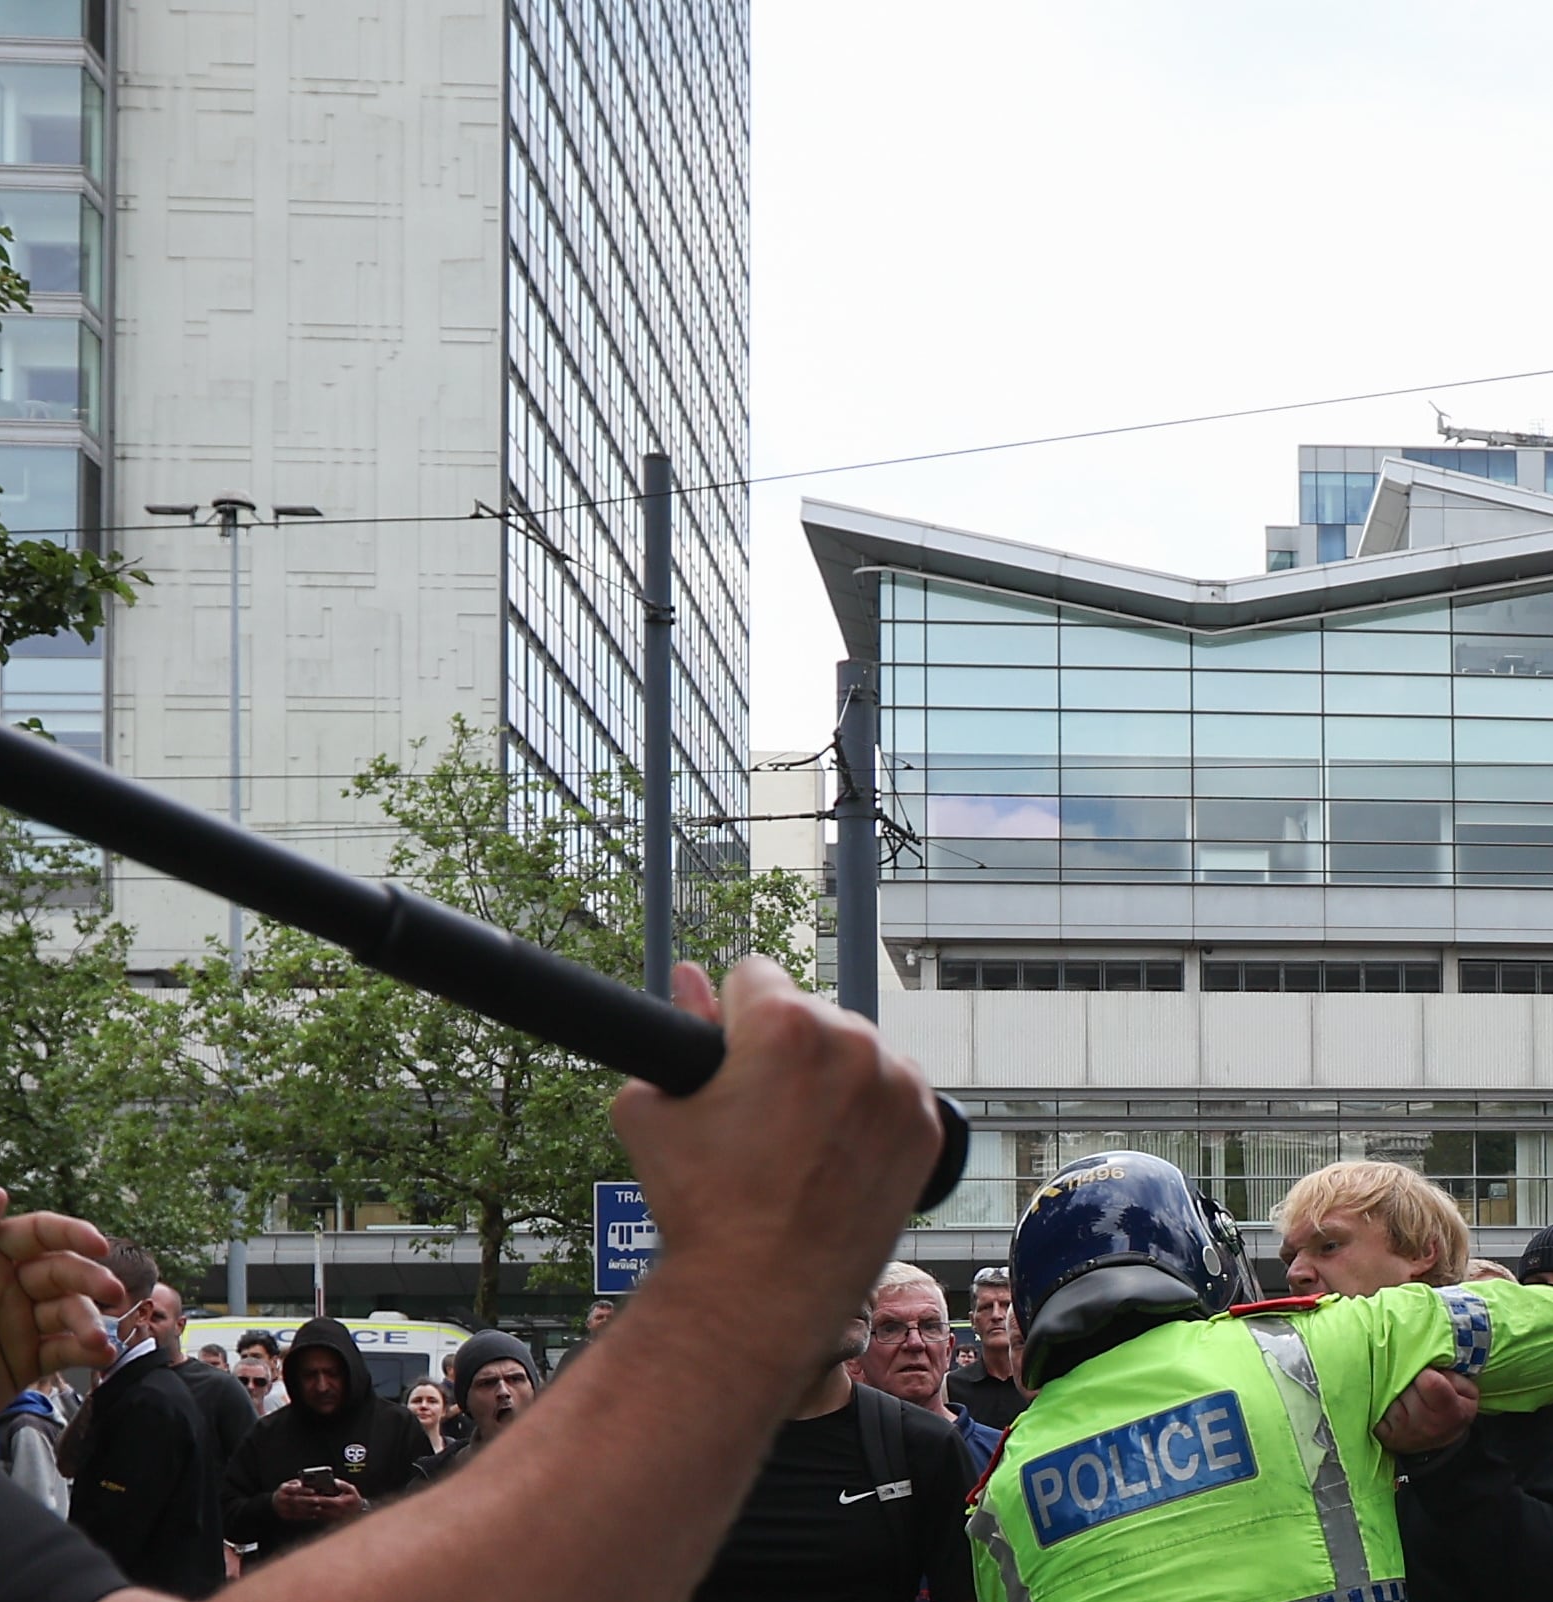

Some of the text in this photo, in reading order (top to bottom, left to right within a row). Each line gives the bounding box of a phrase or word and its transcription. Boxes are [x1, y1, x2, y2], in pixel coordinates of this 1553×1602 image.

[1063, 1166, 1126, 1192] 11496
[615, 1190, 647, 1204] TRA
[1031, 1407, 1242, 1529] POLICE
